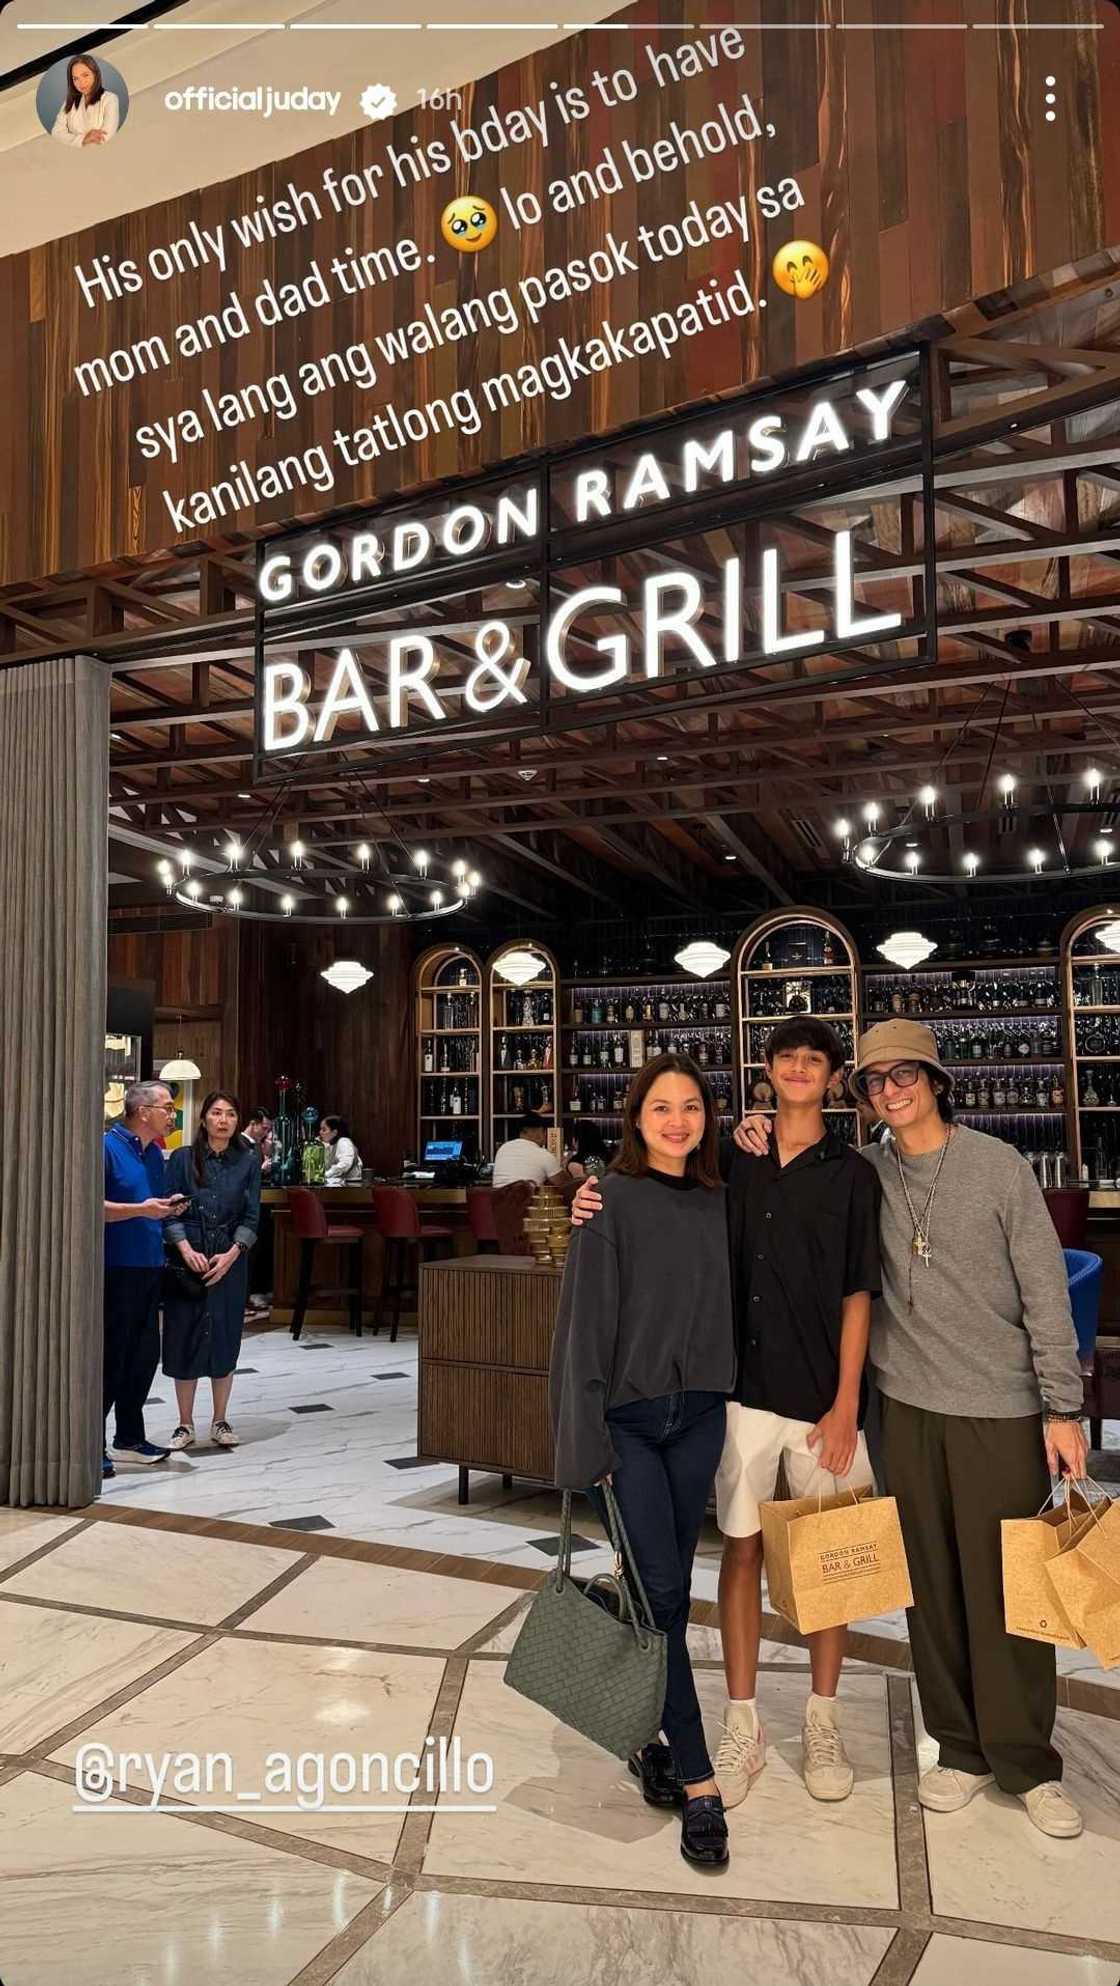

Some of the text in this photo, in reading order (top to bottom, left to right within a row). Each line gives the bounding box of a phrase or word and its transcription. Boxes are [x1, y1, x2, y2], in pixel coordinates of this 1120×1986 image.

[258, 380, 907, 602] GORDON RAMSAY
[264, 530, 902, 751] BAR & GRILL
[822, 1560, 841, 1574] BAR
[843, 1559, 850, 1569] &
[853, 1554, 880, 1566] GRILL
